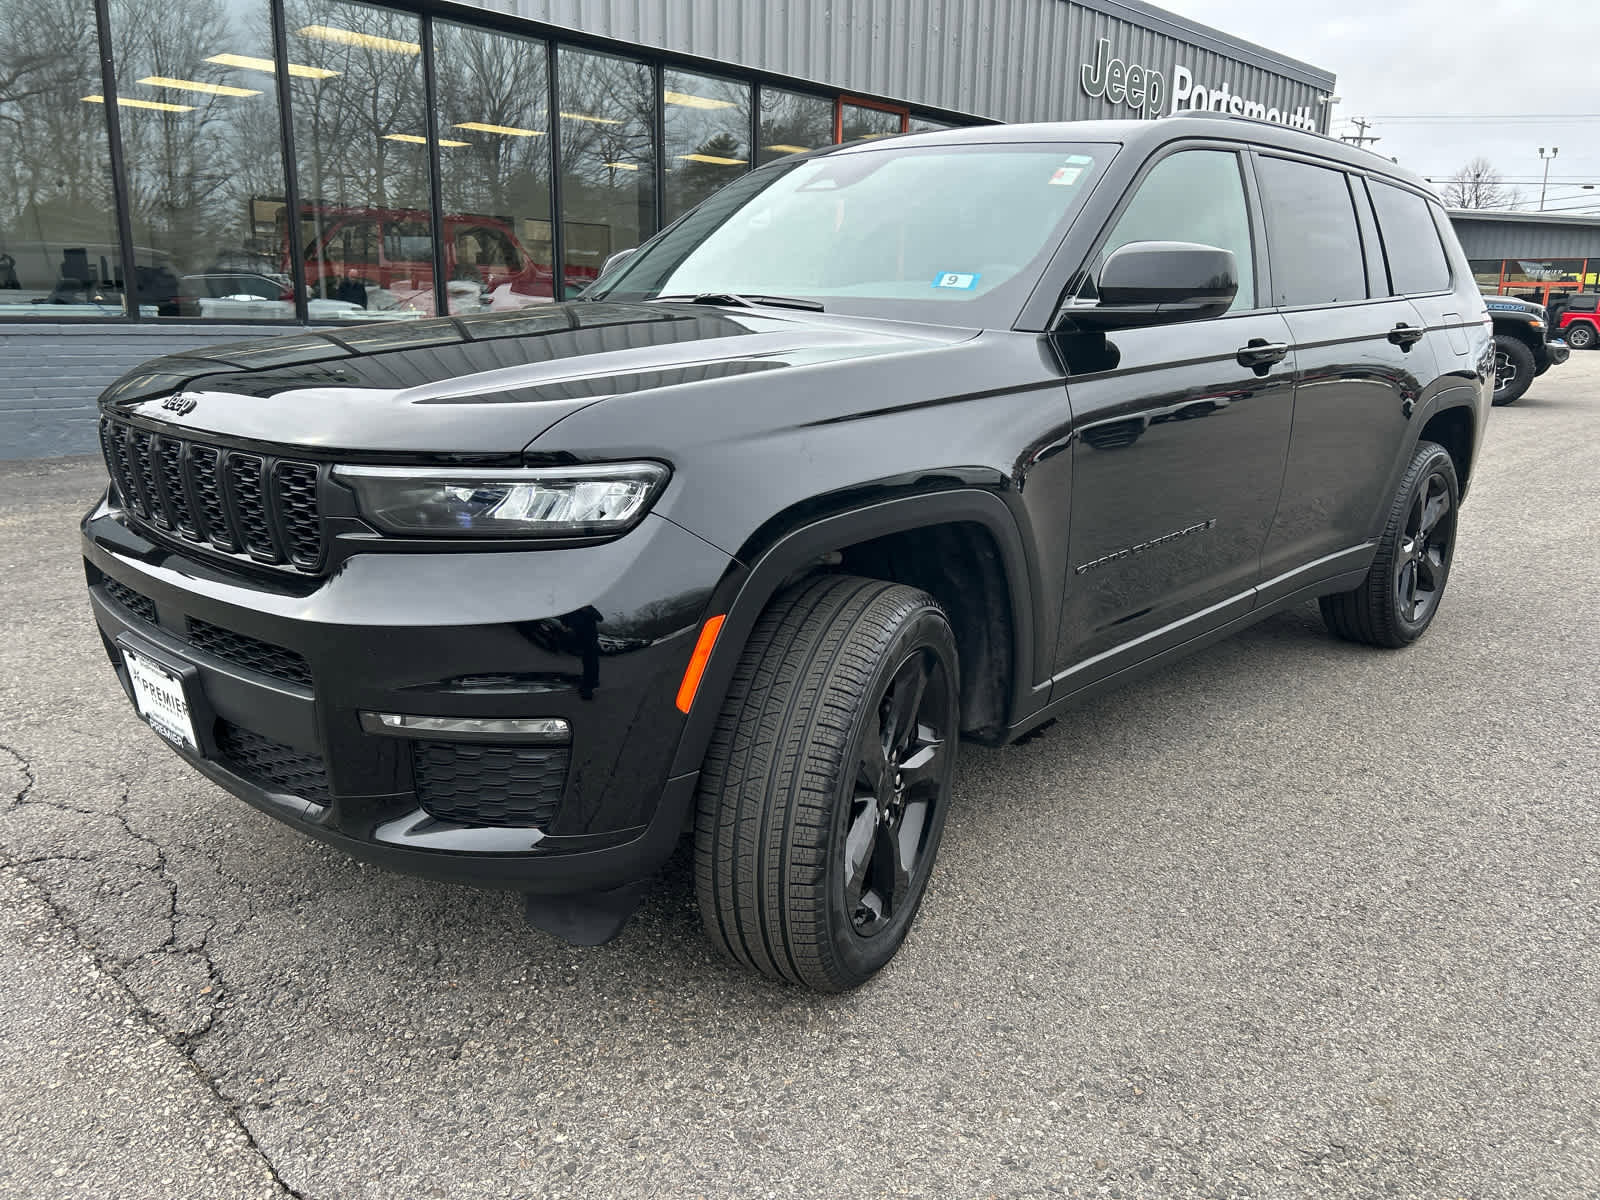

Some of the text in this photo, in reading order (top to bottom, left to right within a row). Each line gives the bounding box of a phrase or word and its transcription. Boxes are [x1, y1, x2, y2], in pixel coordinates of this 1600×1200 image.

[1081, 38, 1316, 132] Jeep Portsmouth
[947, 275, 958, 285] 9
[161, 392, 197, 417] Jeep
[142, 679, 188, 715] PREMIER
